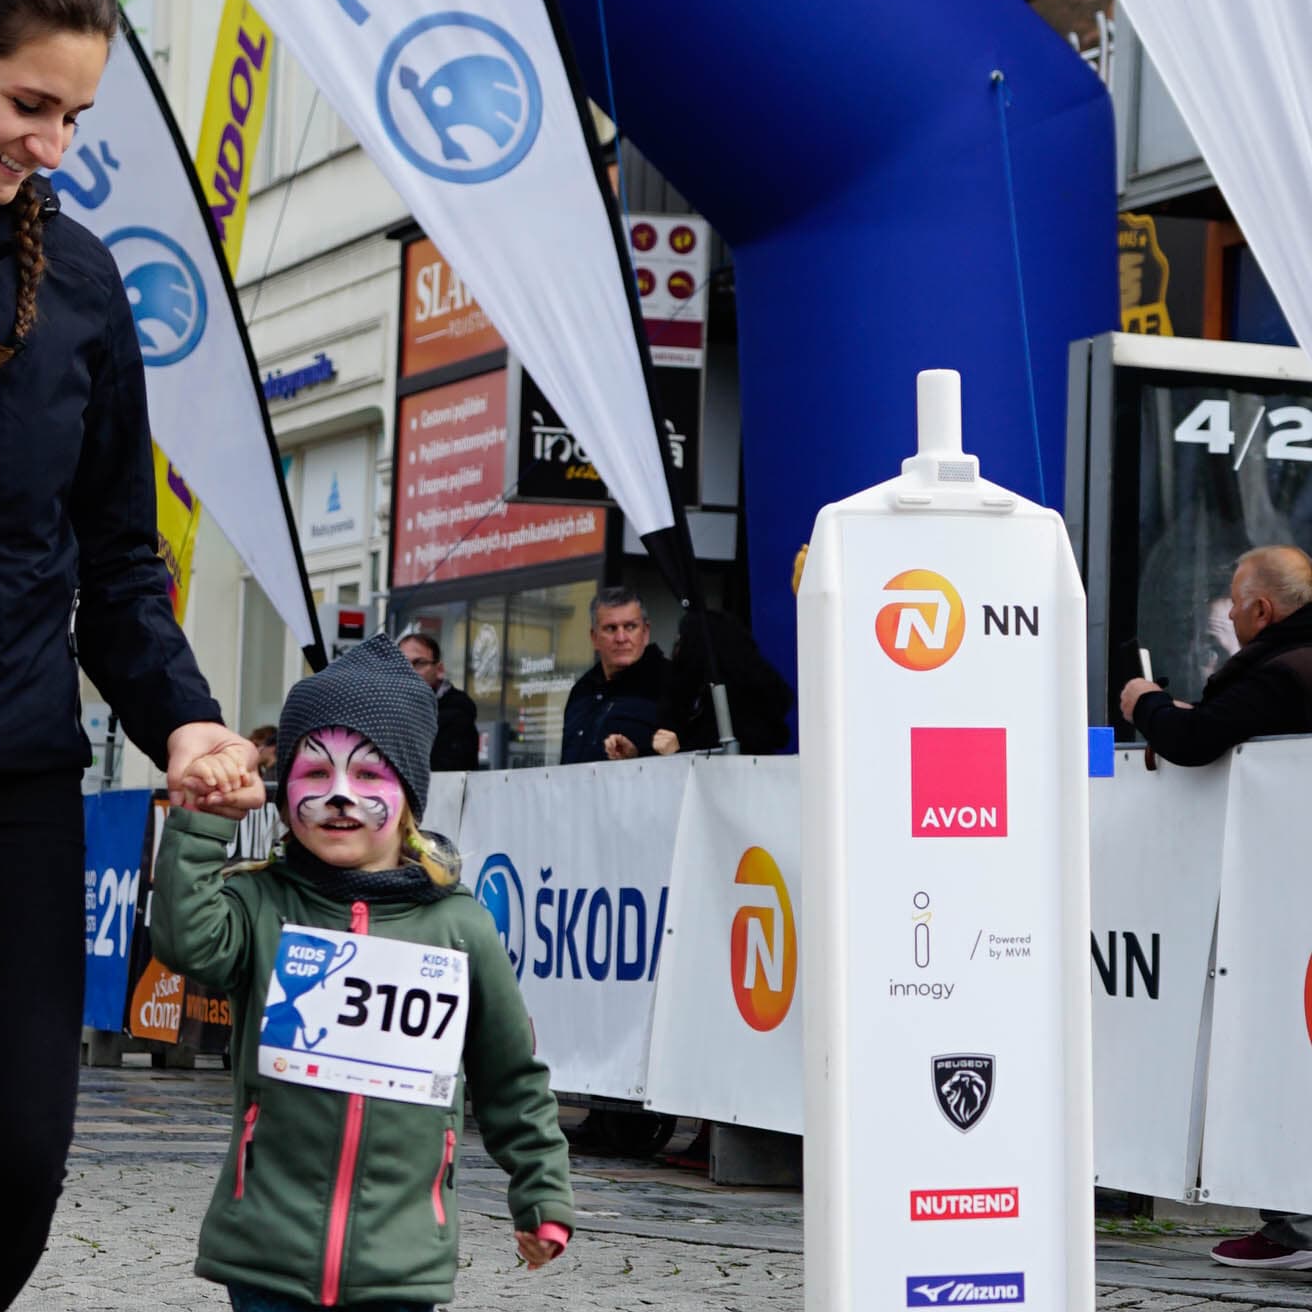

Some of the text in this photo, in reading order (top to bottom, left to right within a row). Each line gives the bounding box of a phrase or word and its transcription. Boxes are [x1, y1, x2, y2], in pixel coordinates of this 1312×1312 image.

[982, 605, 1039, 636] NN
[920, 806, 998, 828] AVON
[988, 934, 1032, 944] Powered
[287, 944, 326, 962] KIDS
[421, 953, 449, 967] KIDS
[988, 948, 1031, 960] by MVM
[284, 961, 320, 977] CUP
[419, 967, 445, 979] CUP
[889, 978, 955, 1000] innogy
[336, 976, 459, 1041] 3107
[937, 1060, 990, 1069] PEUGEOT
[915, 1193, 1015, 1215] NUTREND
